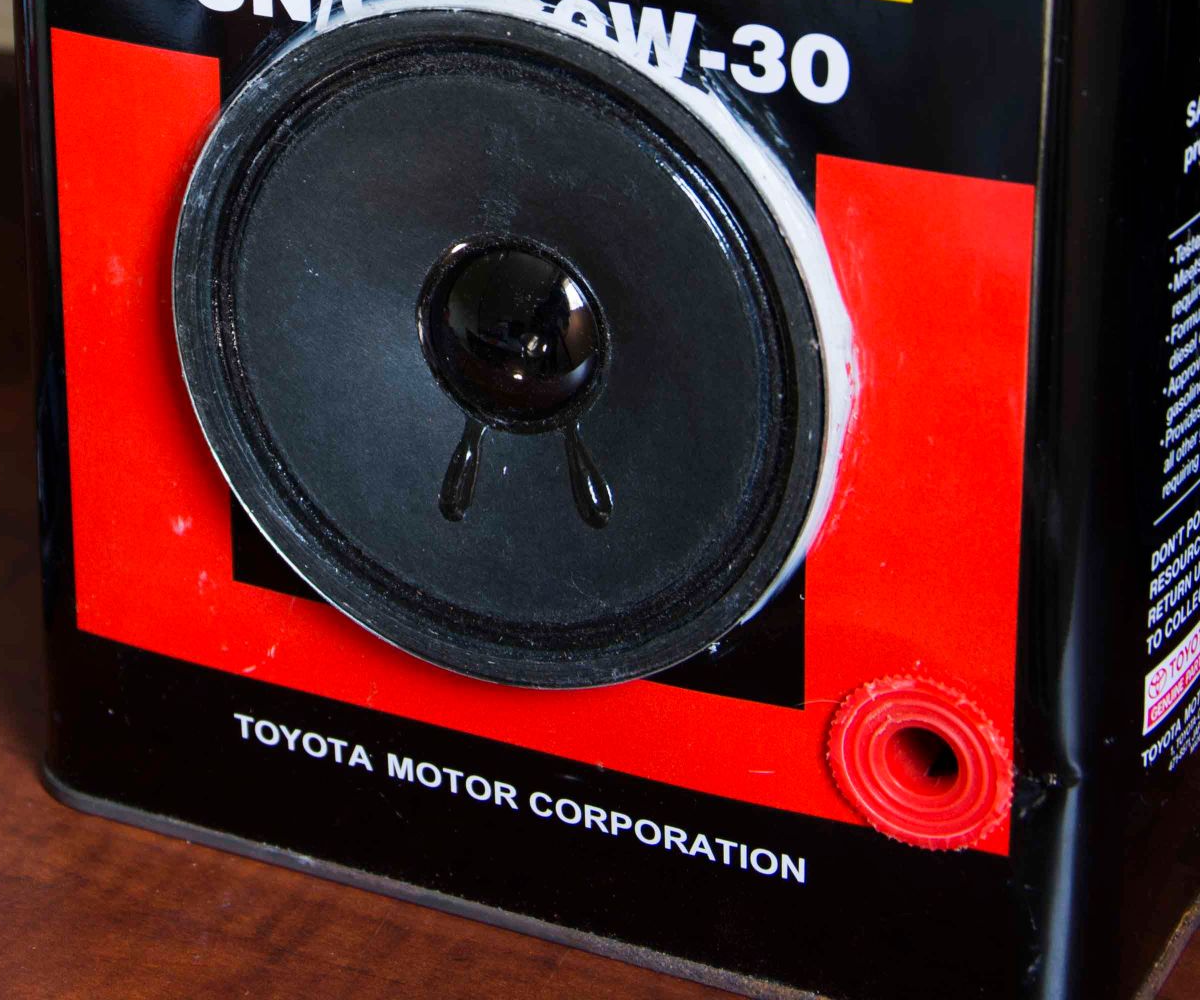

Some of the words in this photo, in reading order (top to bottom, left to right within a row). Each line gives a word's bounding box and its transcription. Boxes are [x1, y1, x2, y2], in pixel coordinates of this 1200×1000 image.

[1151, 525, 1185, 572] DON'T
[1147, 571, 1192, 629] RETURN
[1146, 628, 1162, 655] TO
[1169, 629, 1200, 678] TOYO
[1141, 718, 1181, 768] TOYOTA
[234, 713, 373, 771] TOYOTA
[387, 753, 519, 810] MOTOR
[529, 791, 806, 884] CORPORATION
